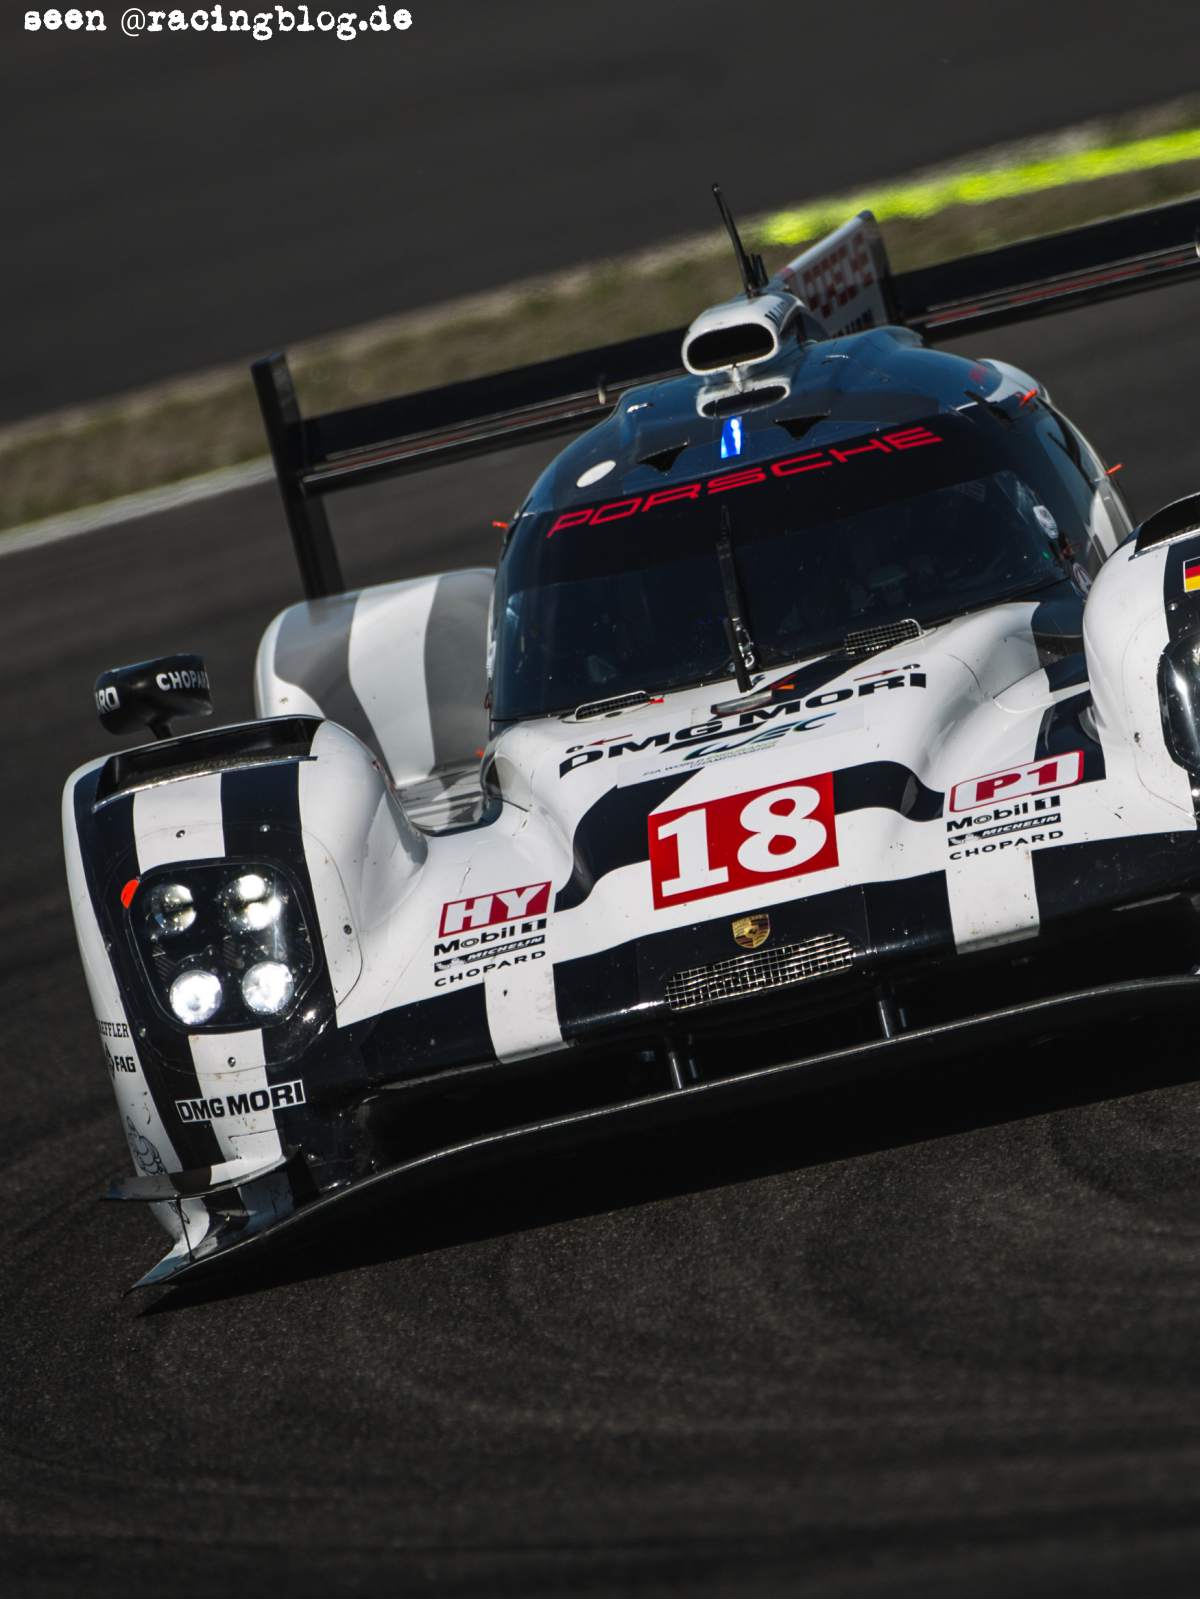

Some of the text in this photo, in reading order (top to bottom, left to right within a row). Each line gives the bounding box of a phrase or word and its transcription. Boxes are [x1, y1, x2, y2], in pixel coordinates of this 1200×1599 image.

[546, 426, 943, 538] PORSCHE
[559, 718, 723, 779] DMG
[738, 672, 928, 727] MORI
[976, 762, 1058, 802] P1
[947, 802, 1028, 832] Mobil
[981, 814, 1059, 838] MICHELIN
[658, 785, 828, 898] 18
[949, 830, 1064, 860] CHOPARD
[443, 884, 547, 934] HY
[433, 925, 516, 956] Mobil
[434, 951, 546, 987] CHOPARD
[113, 1055, 137, 1073] FAG
[177, 1081, 305, 1121] DMG MORI
